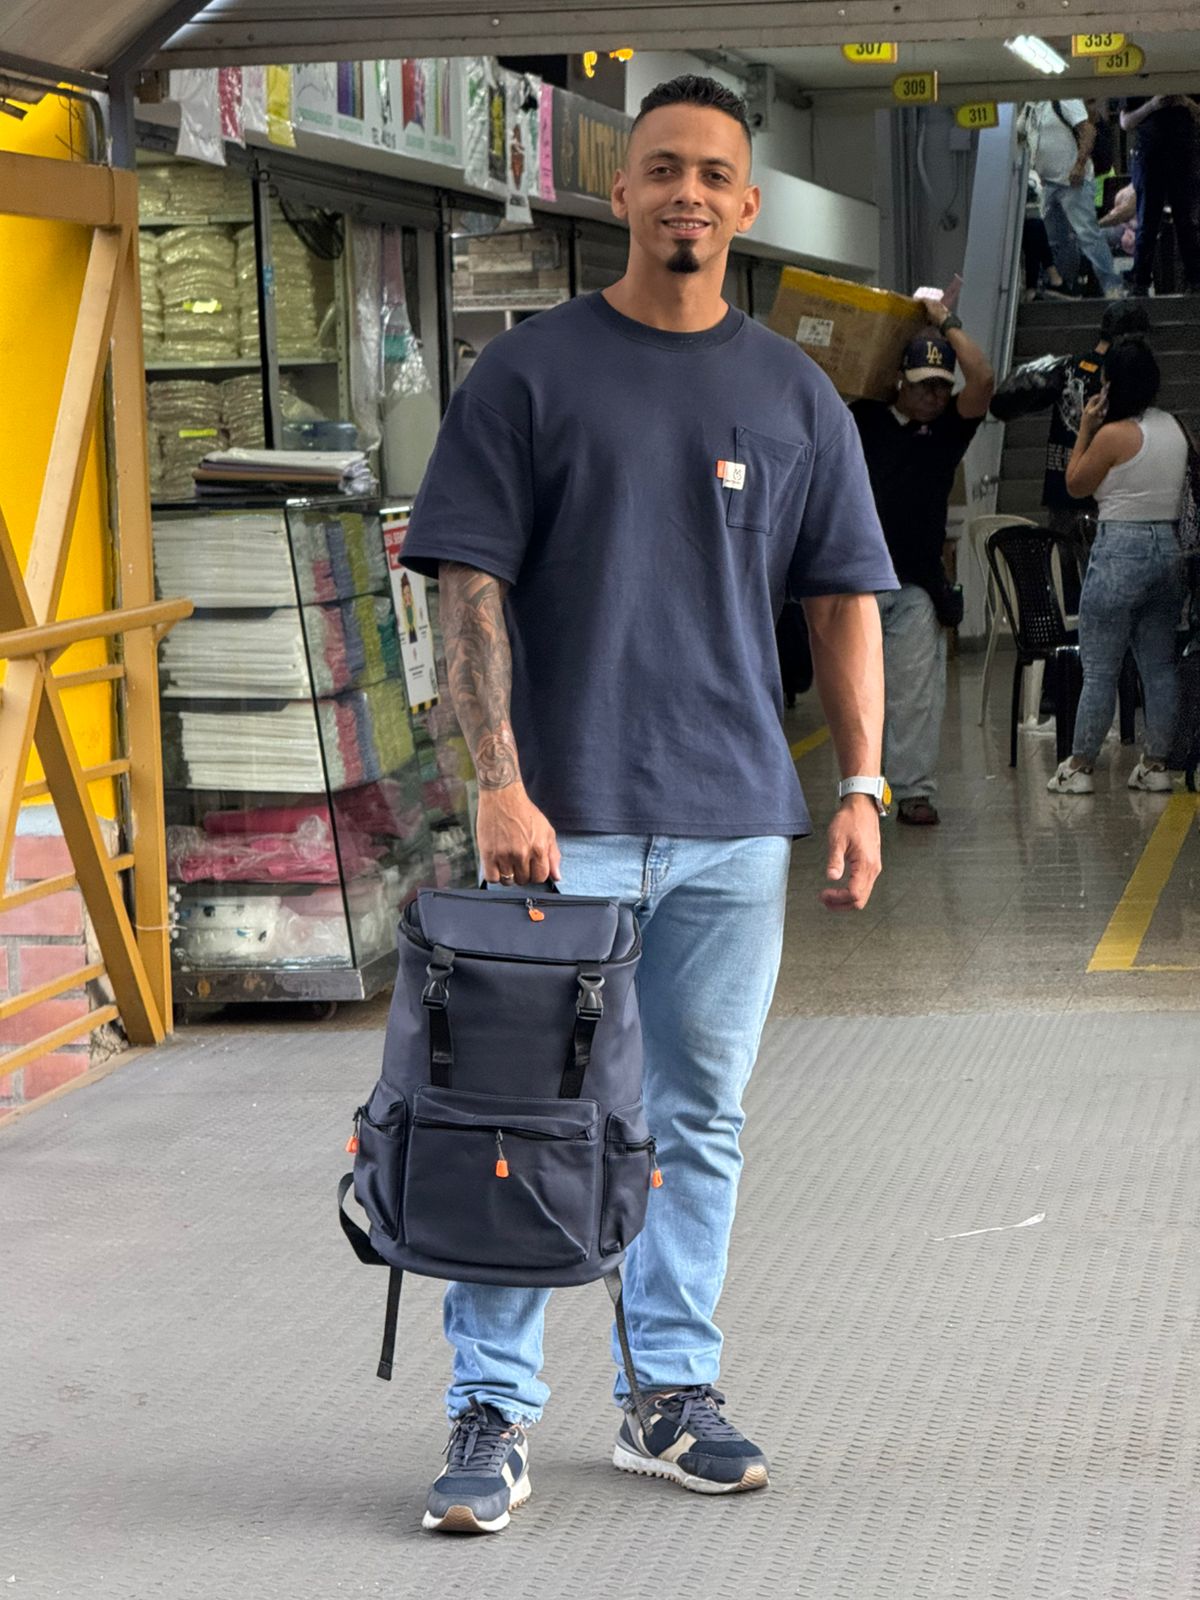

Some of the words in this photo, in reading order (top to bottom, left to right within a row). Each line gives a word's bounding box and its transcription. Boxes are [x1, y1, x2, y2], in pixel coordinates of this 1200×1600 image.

[1085, 34, 1112, 48] 353
[1106, 51, 1129, 68] 351
[904, 79, 926, 96] 309
[968, 108, 988, 123] 311
[926, 341, 943, 364] LA
